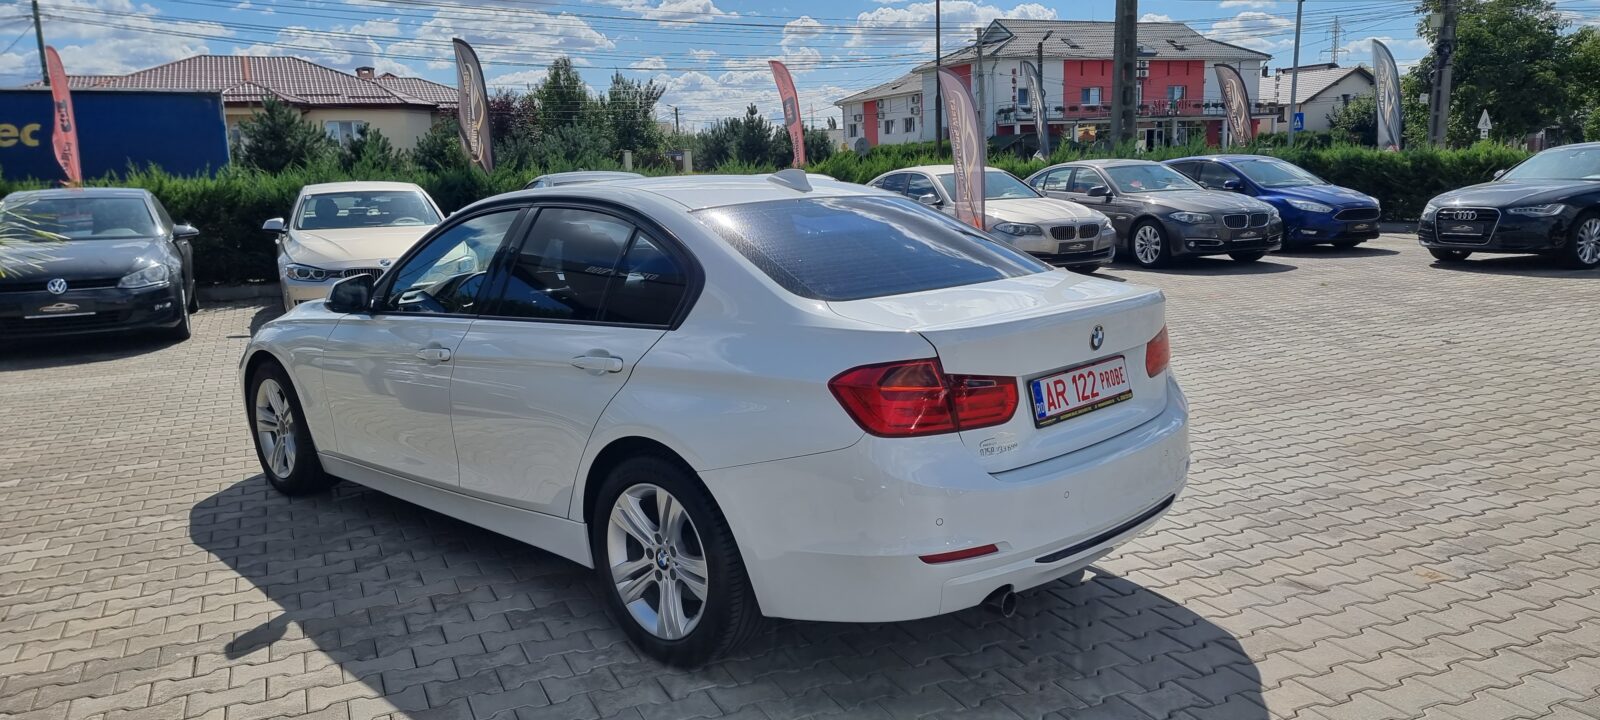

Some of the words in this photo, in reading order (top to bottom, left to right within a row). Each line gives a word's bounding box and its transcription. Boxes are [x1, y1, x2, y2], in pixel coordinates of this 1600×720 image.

[1046, 379, 1069, 411] AR
[1071, 371, 1099, 402] 122
[1100, 366, 1126, 390] PROBE
